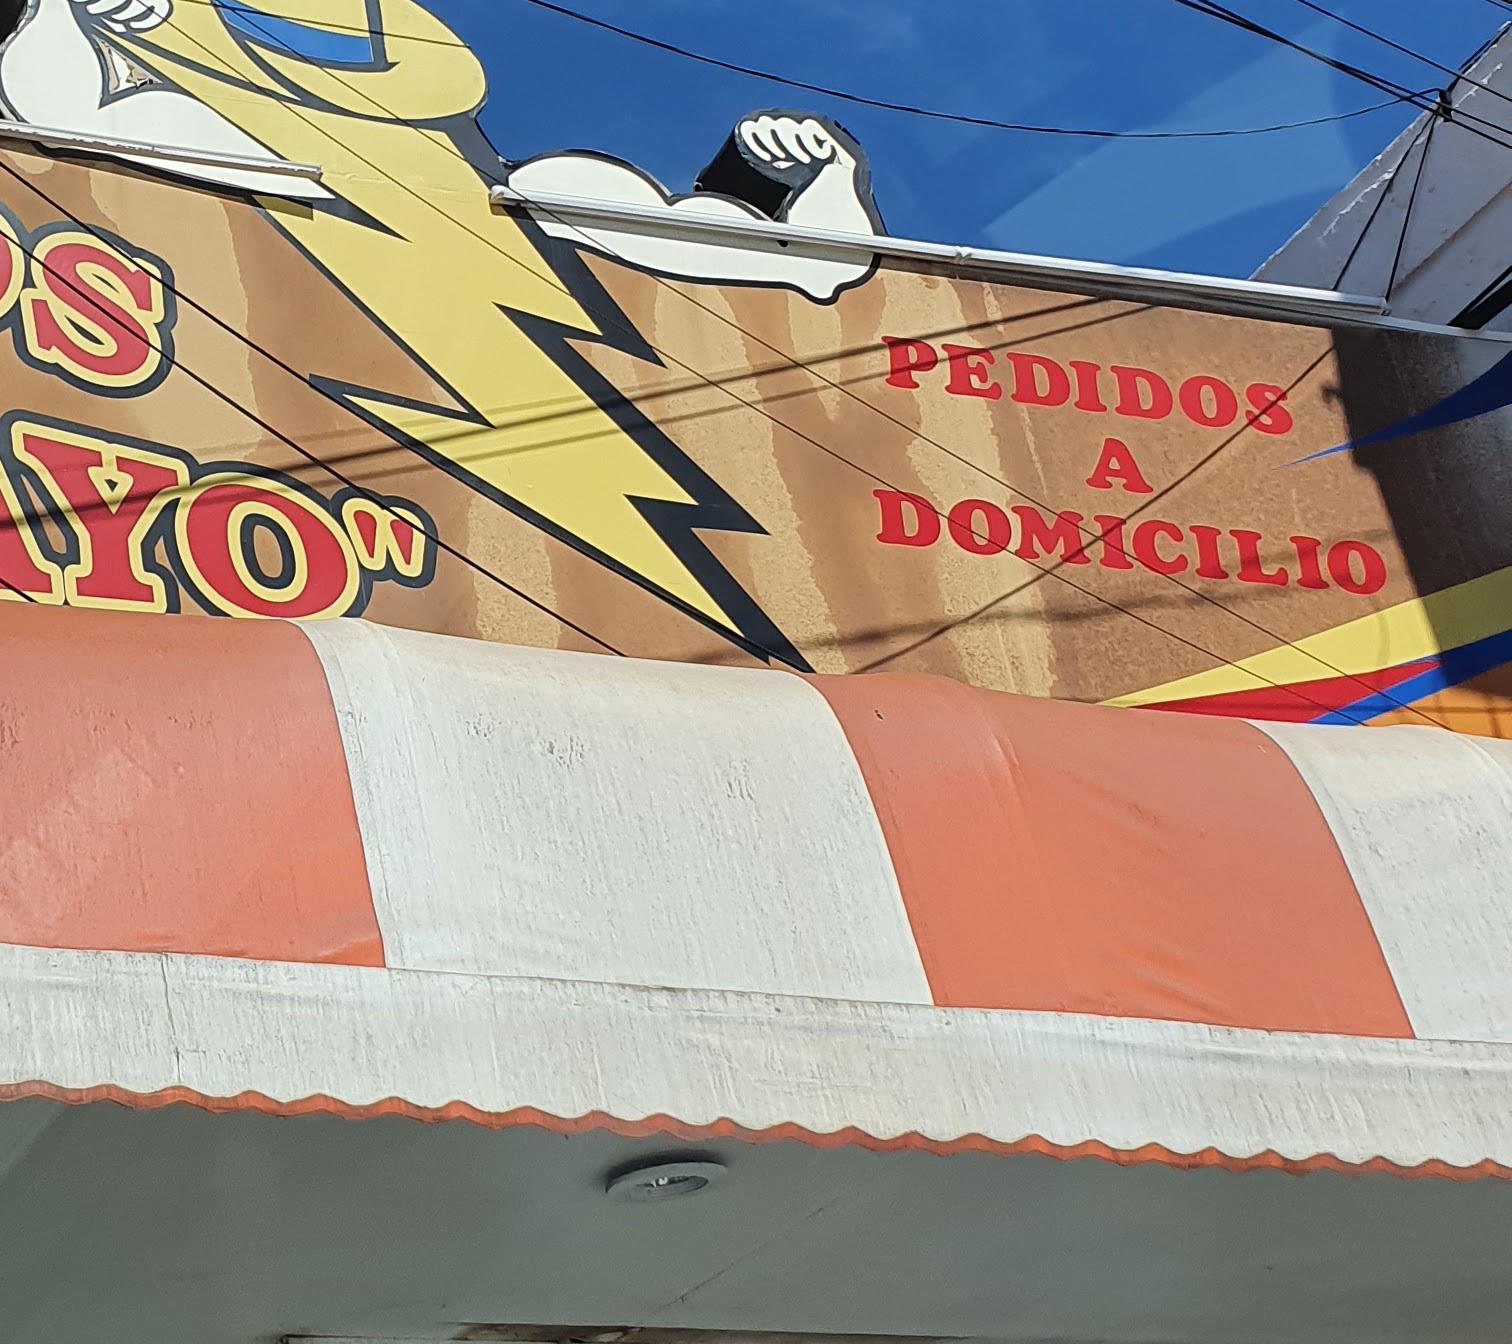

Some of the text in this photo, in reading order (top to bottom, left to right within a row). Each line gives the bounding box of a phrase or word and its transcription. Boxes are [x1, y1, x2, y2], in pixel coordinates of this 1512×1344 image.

[880, 335, 1294, 436] PEDIDOS
[1085, 436, 1154, 495] A
[872, 488, 1388, 596] DOMICILIO
